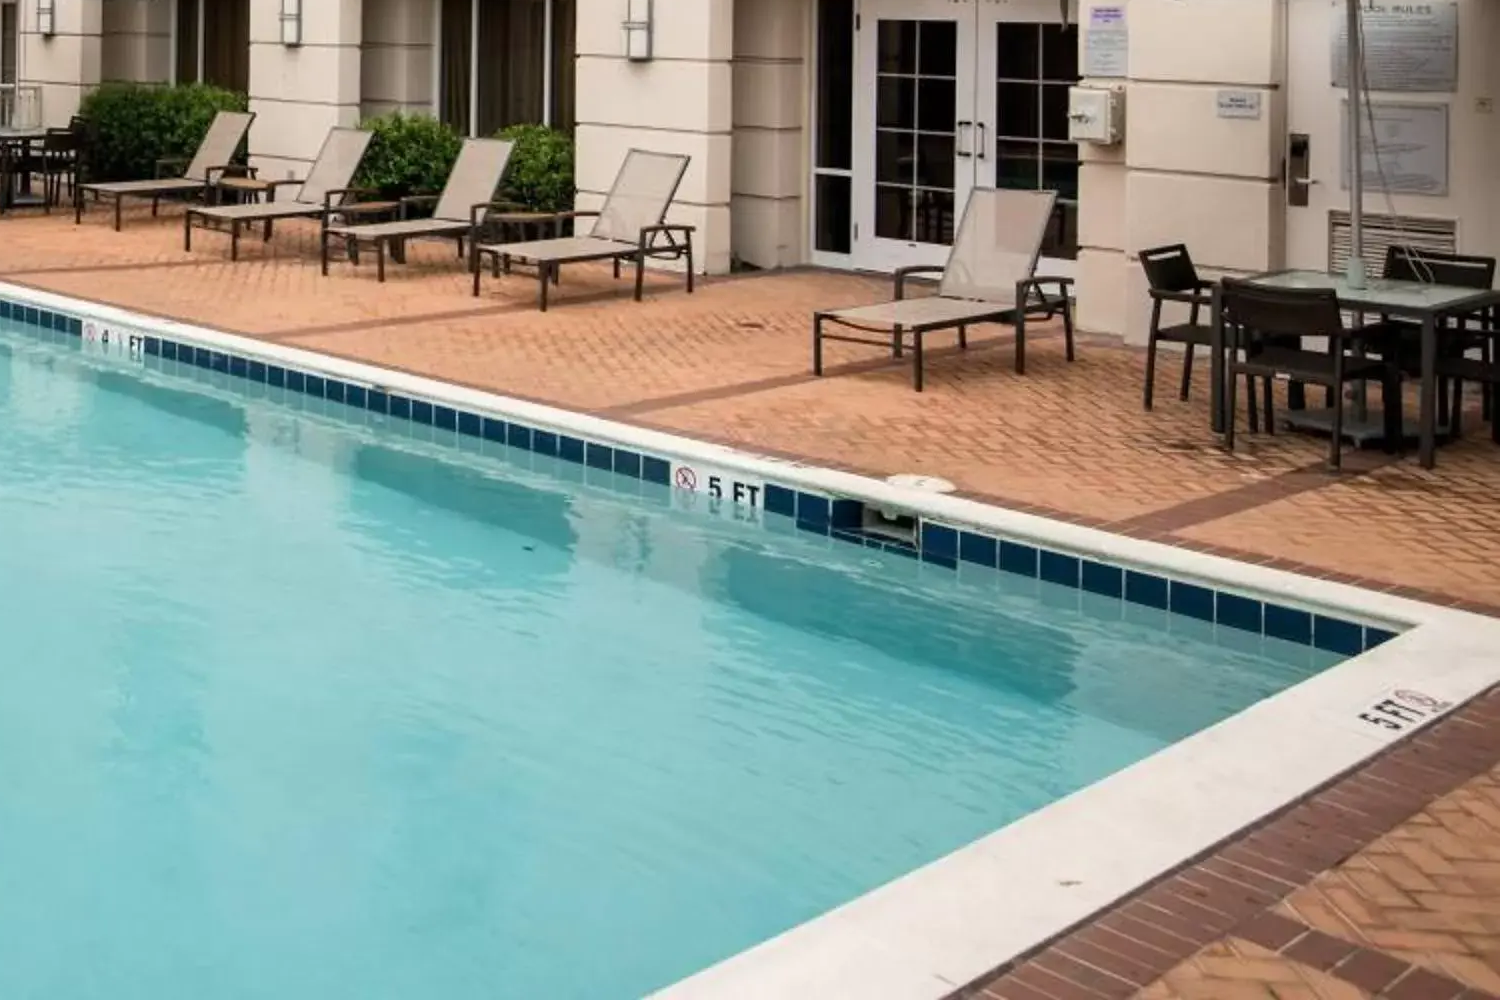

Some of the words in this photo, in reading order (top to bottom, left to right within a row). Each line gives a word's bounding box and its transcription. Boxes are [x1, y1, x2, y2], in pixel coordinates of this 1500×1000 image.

[708, 475, 723, 499] 5
[732, 480, 761, 507] FT
[1357, 712, 1402, 730] 5
[1373, 699, 1427, 723] FT
